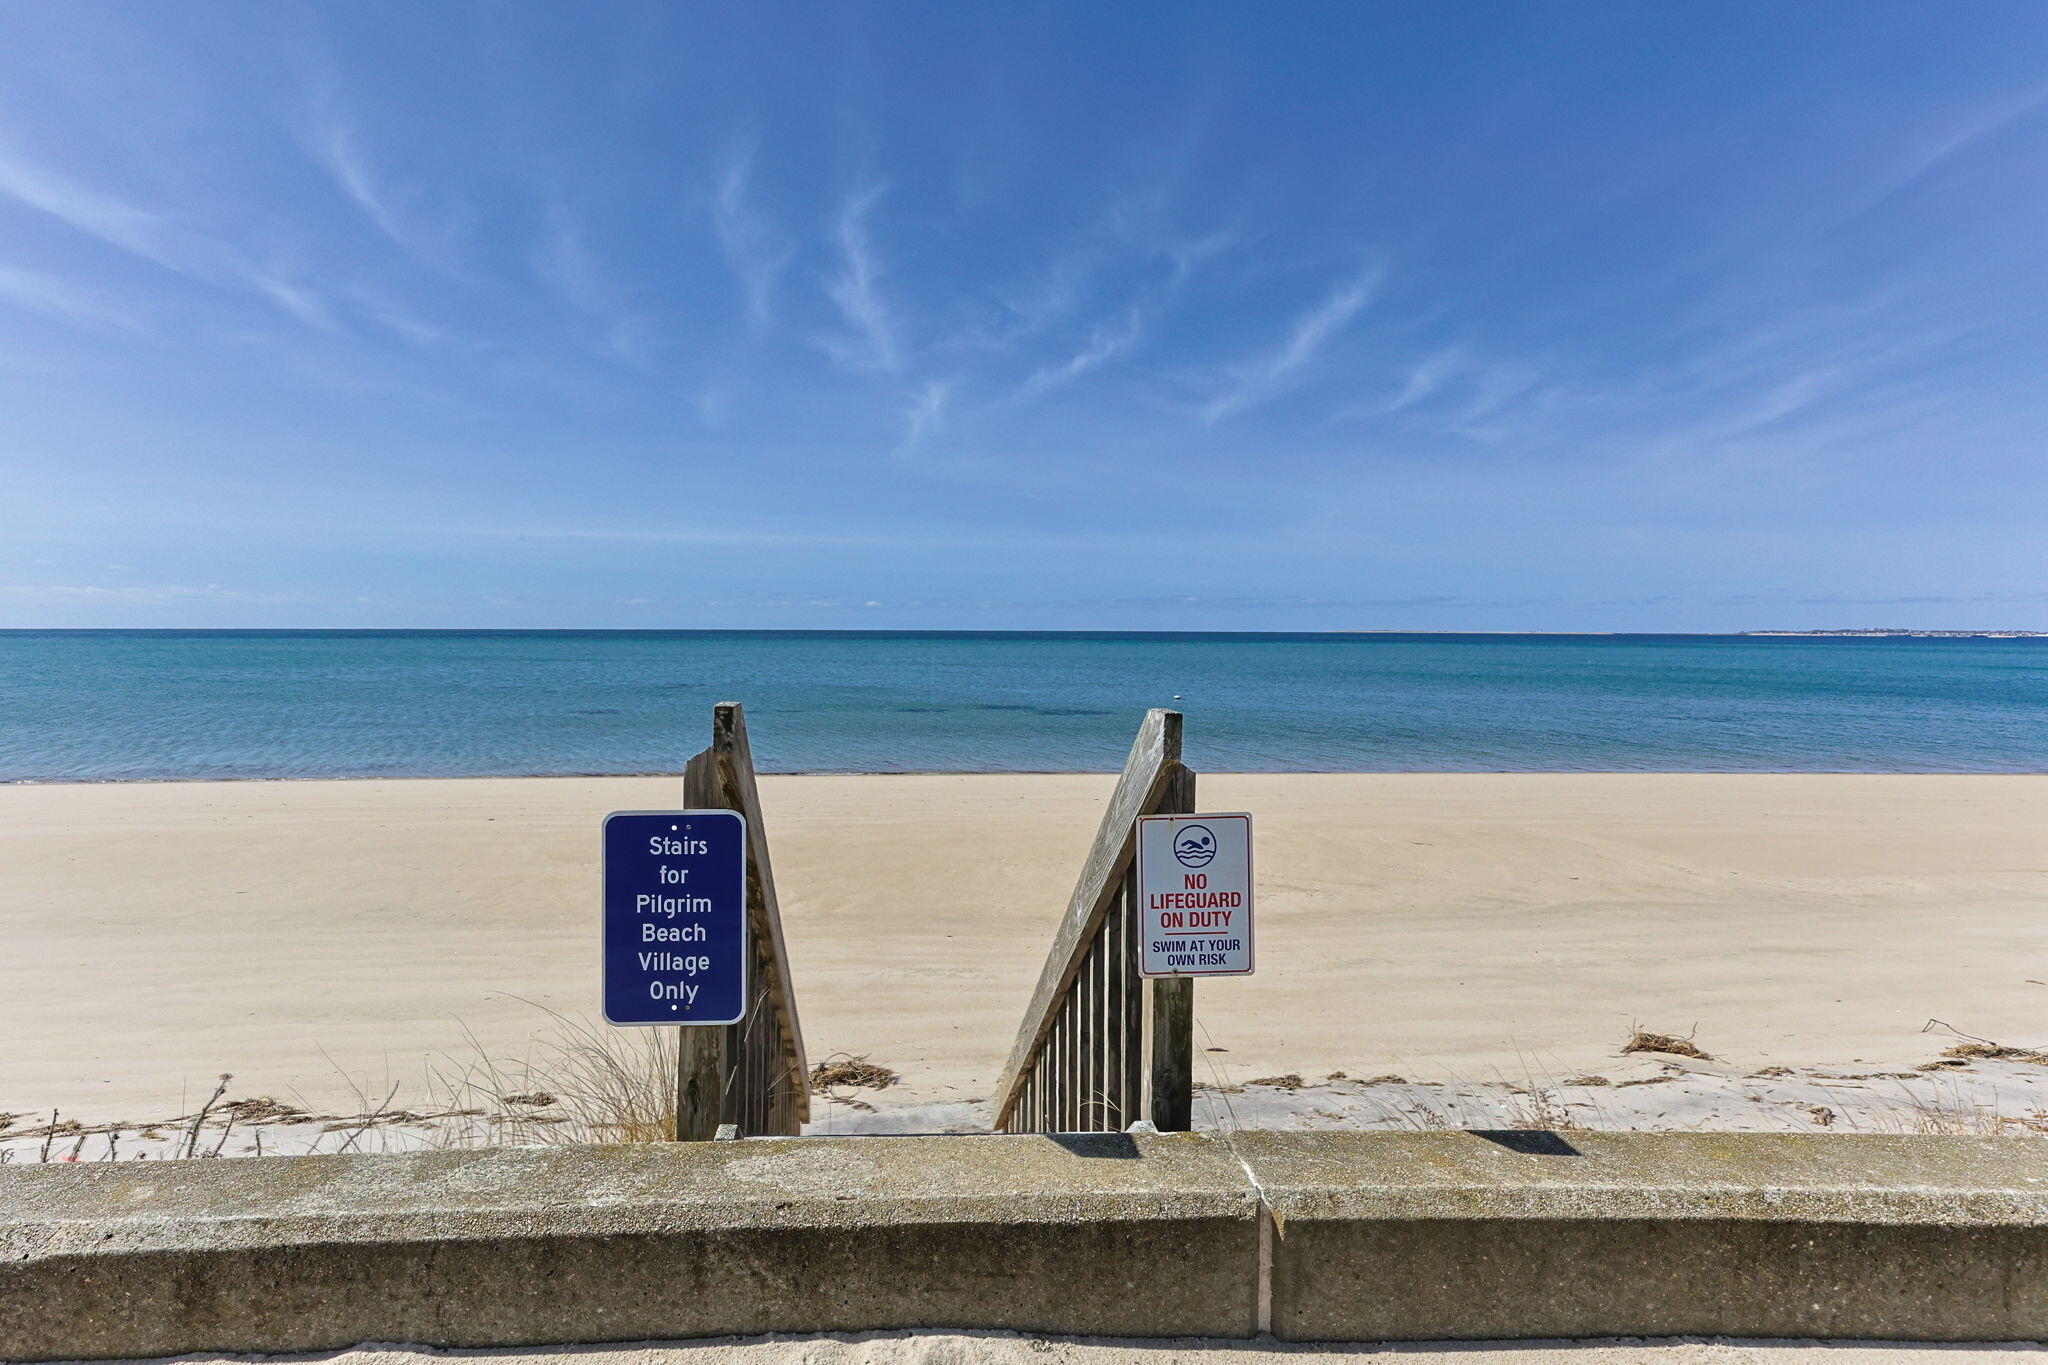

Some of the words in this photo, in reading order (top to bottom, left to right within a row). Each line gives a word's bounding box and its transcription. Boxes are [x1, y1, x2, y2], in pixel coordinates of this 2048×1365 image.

[650, 836, 708, 855] Stairs
[659, 865, 689, 884] for
[1184, 873, 1208, 890] NO
[636, 894, 712, 919] Pilgrim
[1150, 891, 1242, 910] LIFEGUARD
[1160, 912, 1183, 929] ON
[1189, 910, 1233, 928] DUTY
[642, 923, 706, 942] Beach
[1152, 940, 1186, 953] SWIM
[1189, 939, 1205, 952] AT
[1208, 939, 1241, 952] YOUR
[638, 952, 710, 977] Village
[1167, 953, 1195, 966] OWN
[1198, 953, 1227, 966] RISK
[650, 981, 699, 1004] Only
